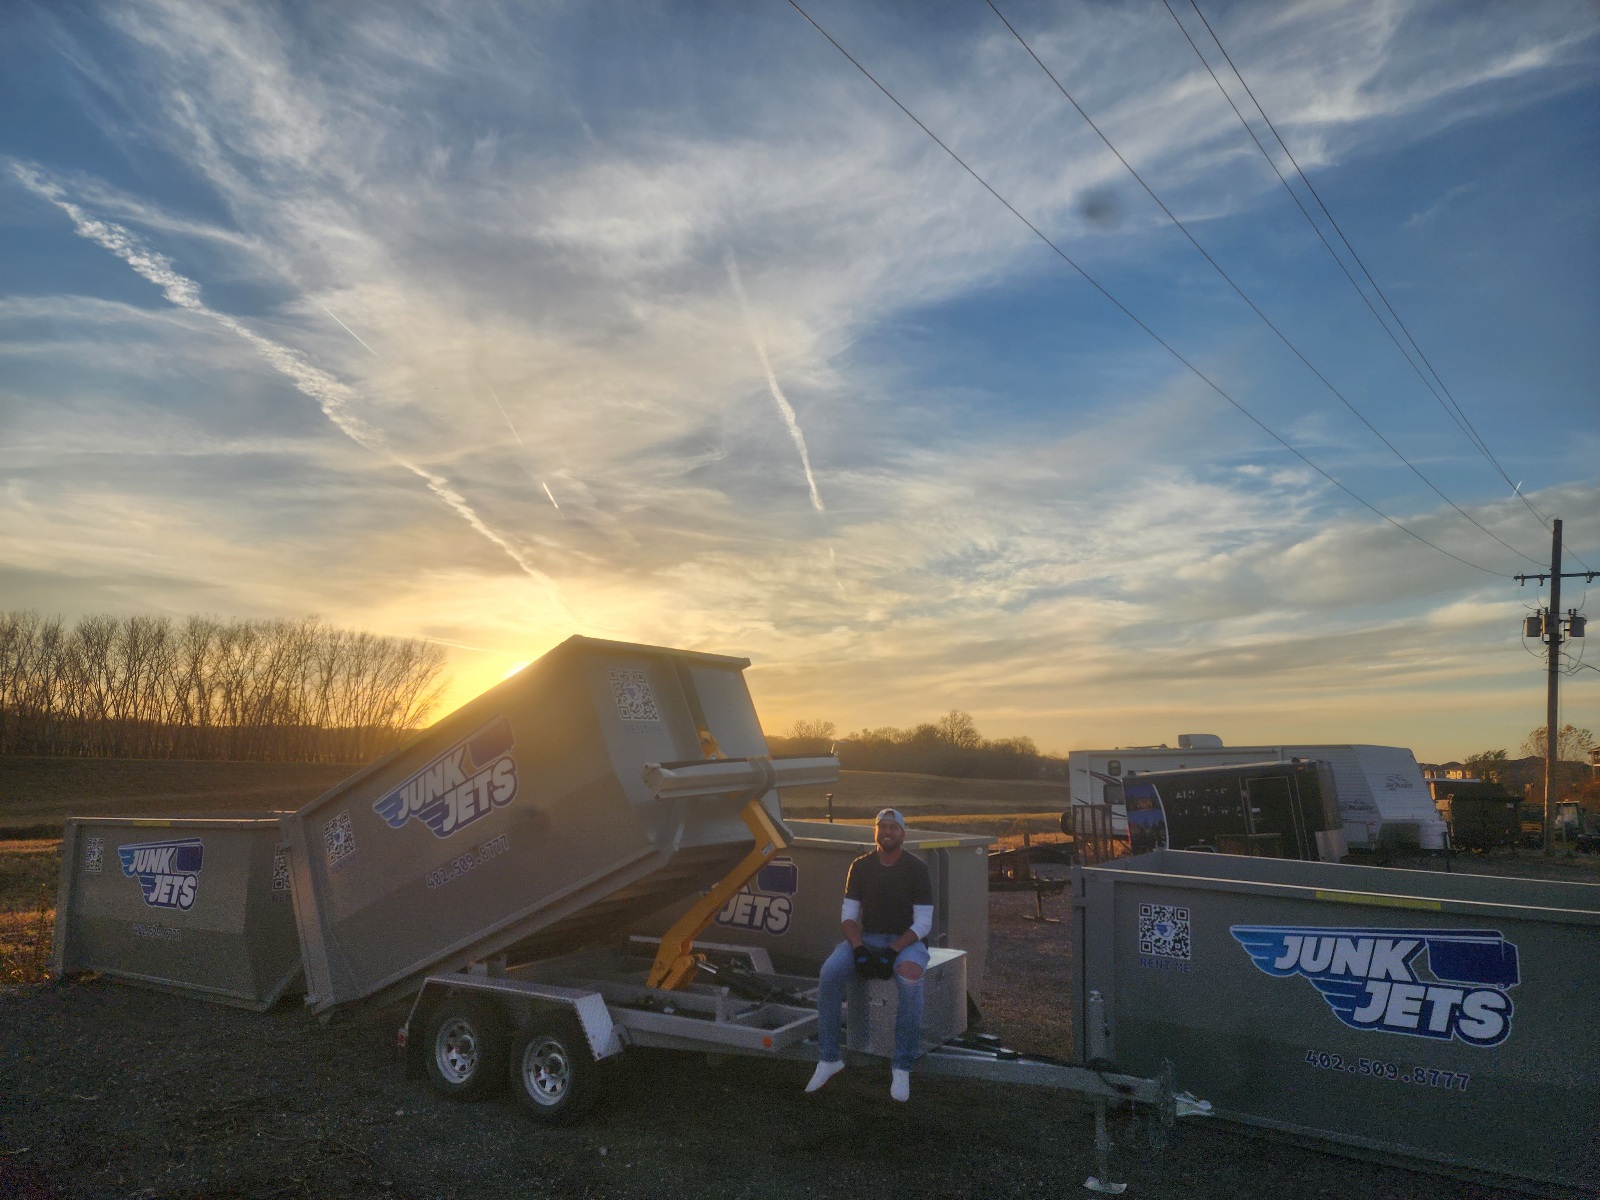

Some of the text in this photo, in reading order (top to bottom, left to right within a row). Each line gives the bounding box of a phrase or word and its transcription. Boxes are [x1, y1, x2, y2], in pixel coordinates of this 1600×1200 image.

[397, 747, 465, 820] JUNK
[442, 758, 516, 833] JETS
[129, 847, 176, 874] JUNK
[426, 833, 510, 889] 402.509.8777
[149, 875, 198, 907] JETS
[719, 894, 791, 931] JETS
[1140, 957, 1191, 973] RENT ME
[1274, 936, 1420, 982] JUNK
[1352, 984, 1509, 1040] JETS
[1304, 1049, 1471, 1092] 402.509.8777
